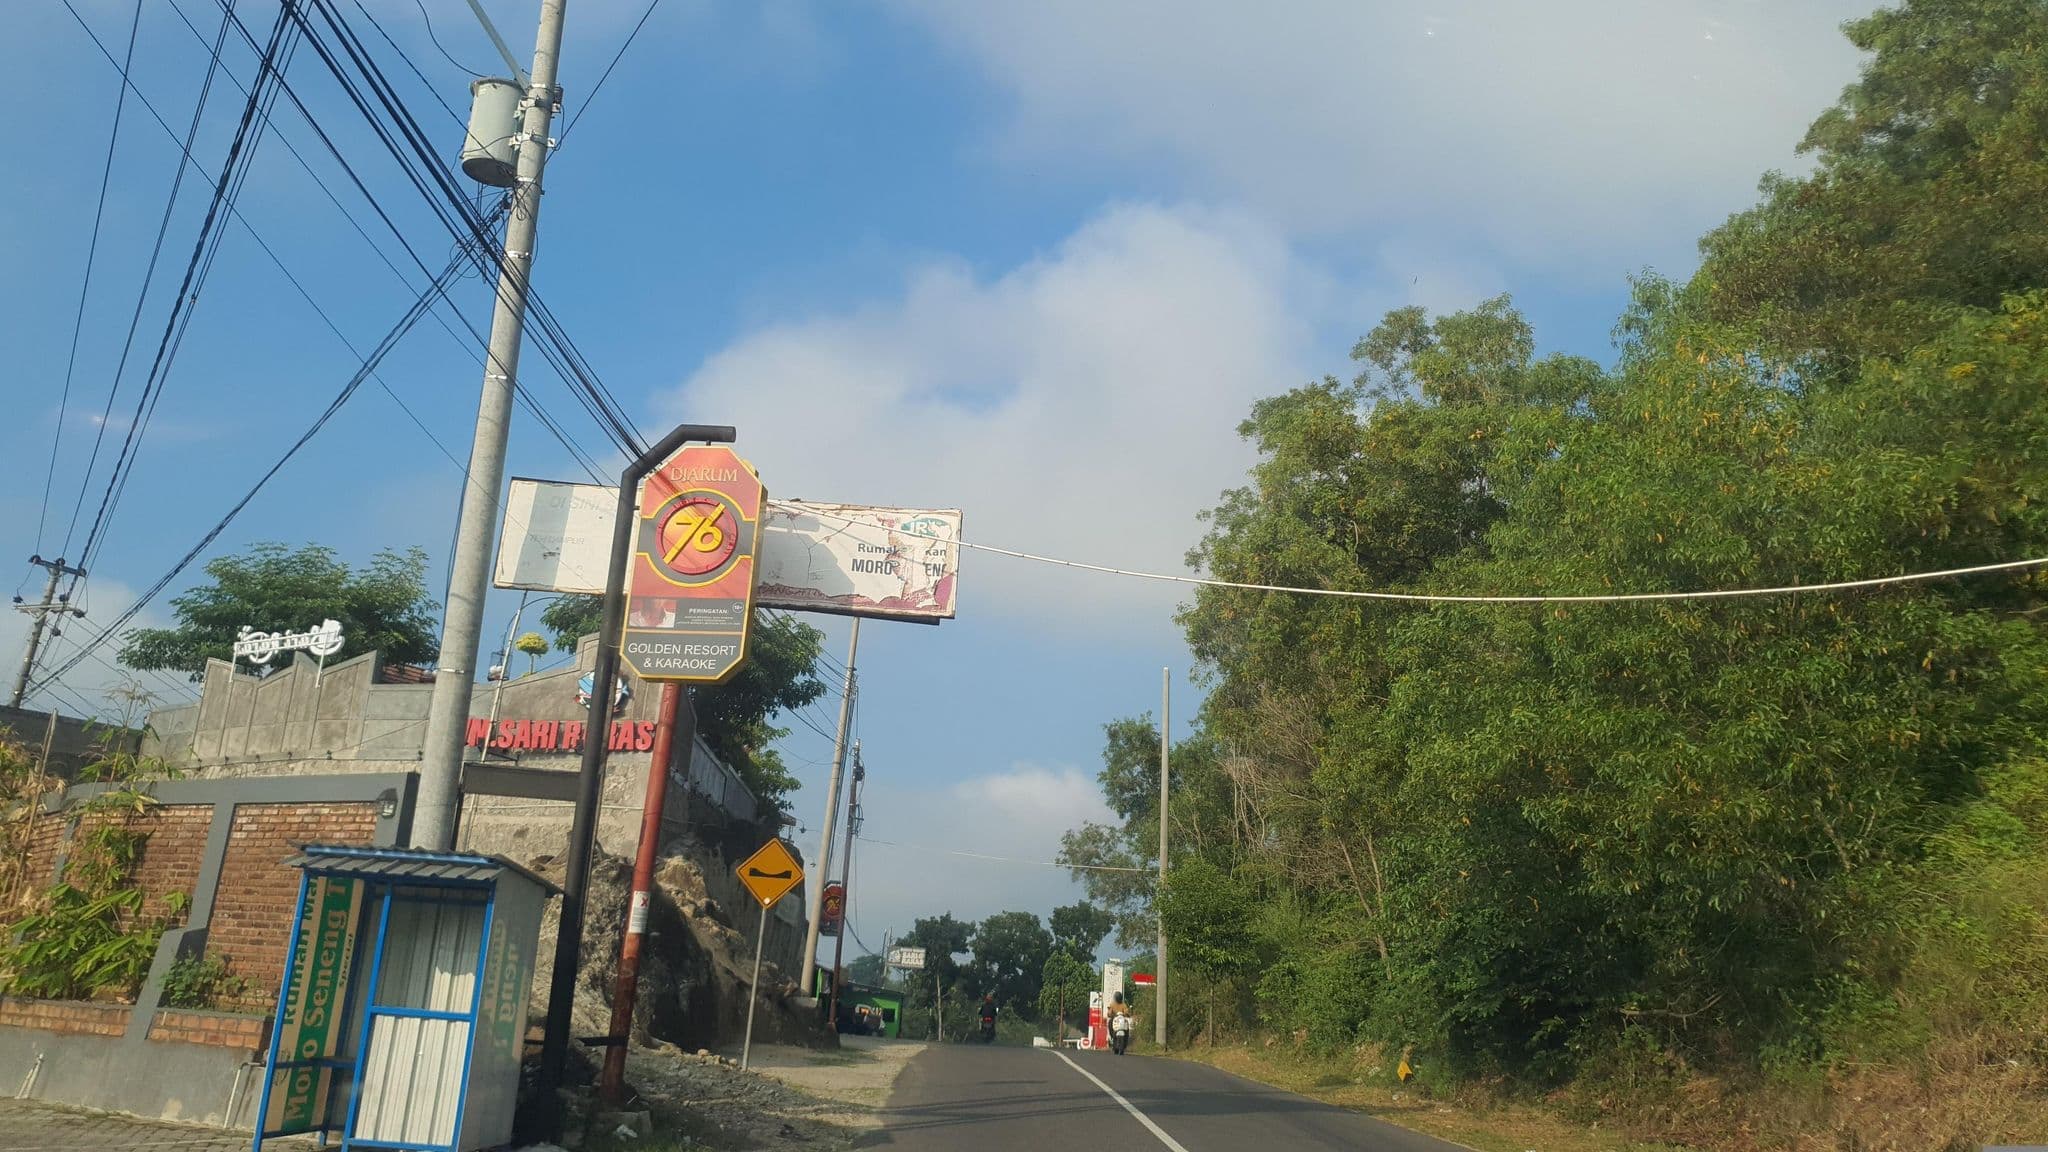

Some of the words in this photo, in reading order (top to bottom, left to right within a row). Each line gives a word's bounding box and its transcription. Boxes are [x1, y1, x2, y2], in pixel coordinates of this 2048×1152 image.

[670, 467, 738, 482] DJARUM
[663, 503, 726, 565] 76
[628, 642, 681, 655] GOLDEN
[684, 643, 736, 656] RESORT
[643, 657, 652, 668] &
[655, 657, 717, 669] KARAOKE
[304, 910, 348, 1028] Seneng
